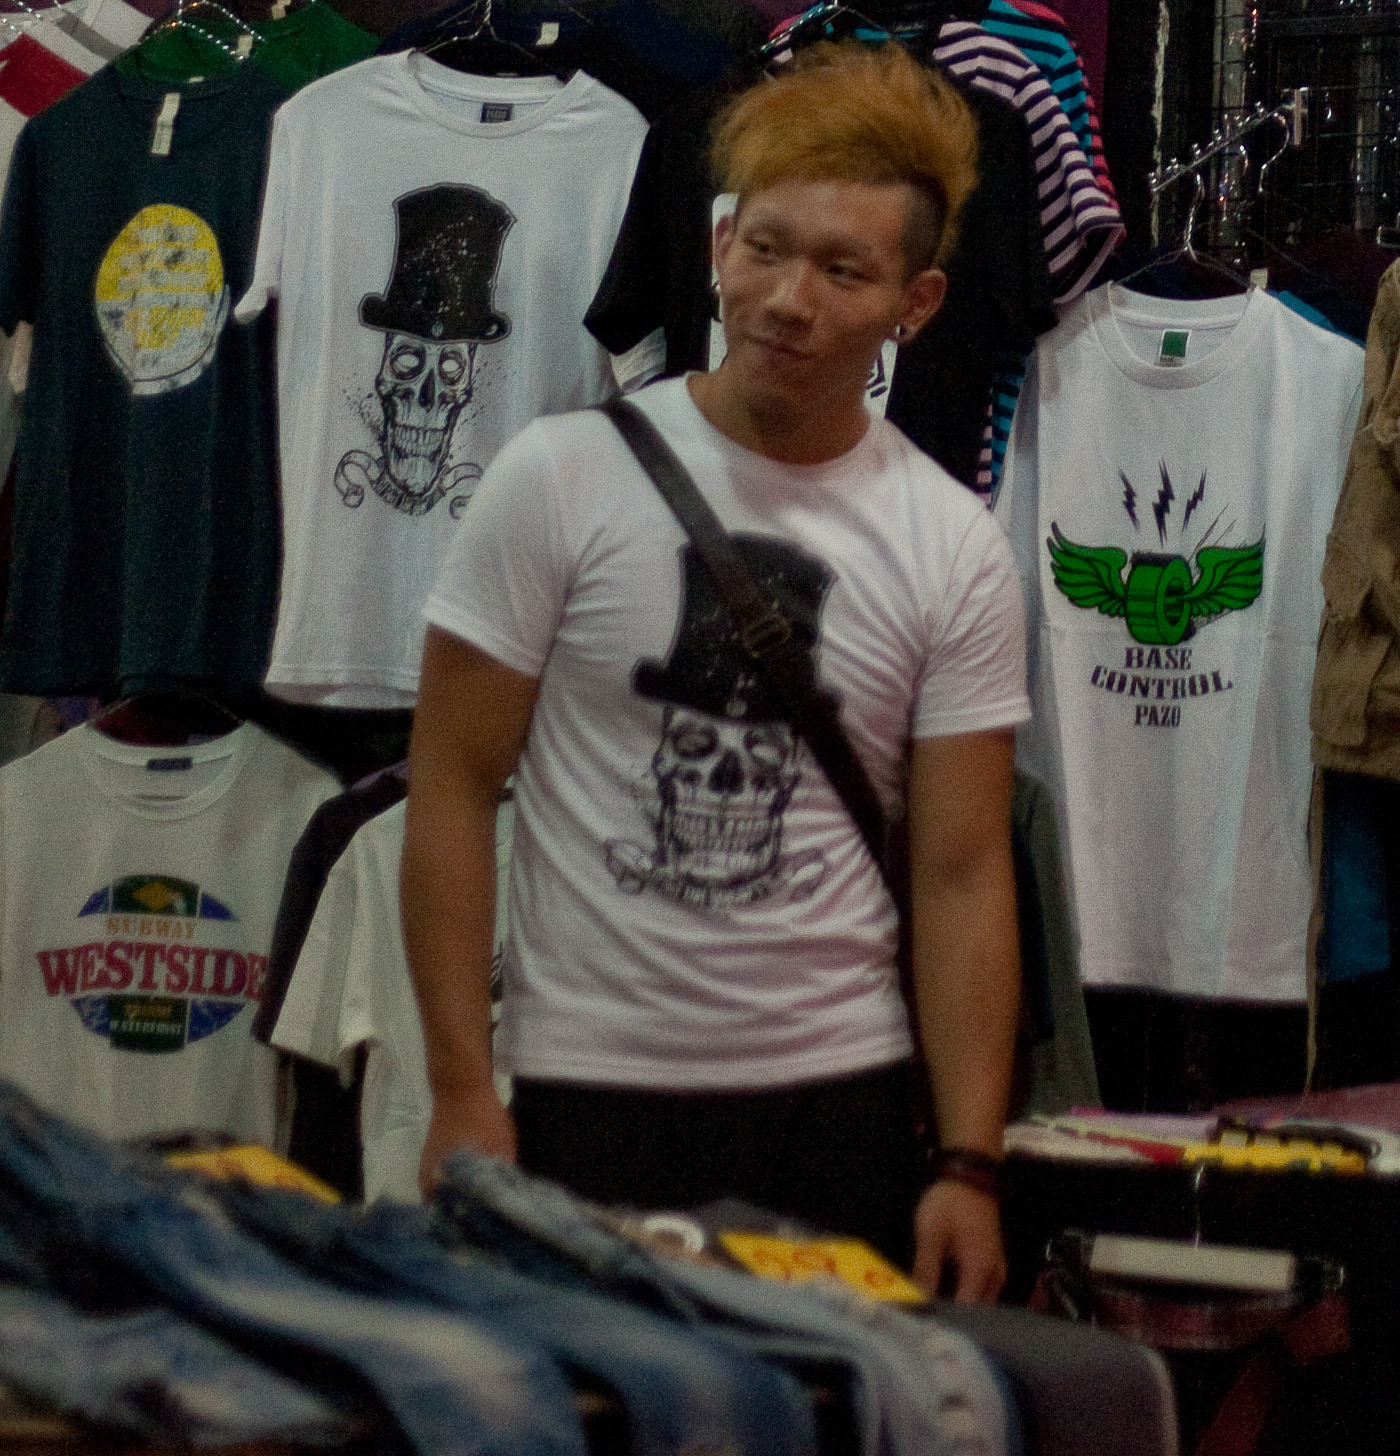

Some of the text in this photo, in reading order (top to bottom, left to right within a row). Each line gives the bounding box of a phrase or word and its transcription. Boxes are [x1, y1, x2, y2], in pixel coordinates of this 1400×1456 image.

[1124, 646, 1193, 670] BASE
[1090, 665, 1234, 700] CONTROL
[1134, 704, 1182, 728] PAZO
[36, 940, 270, 1003] WESTSIDE
